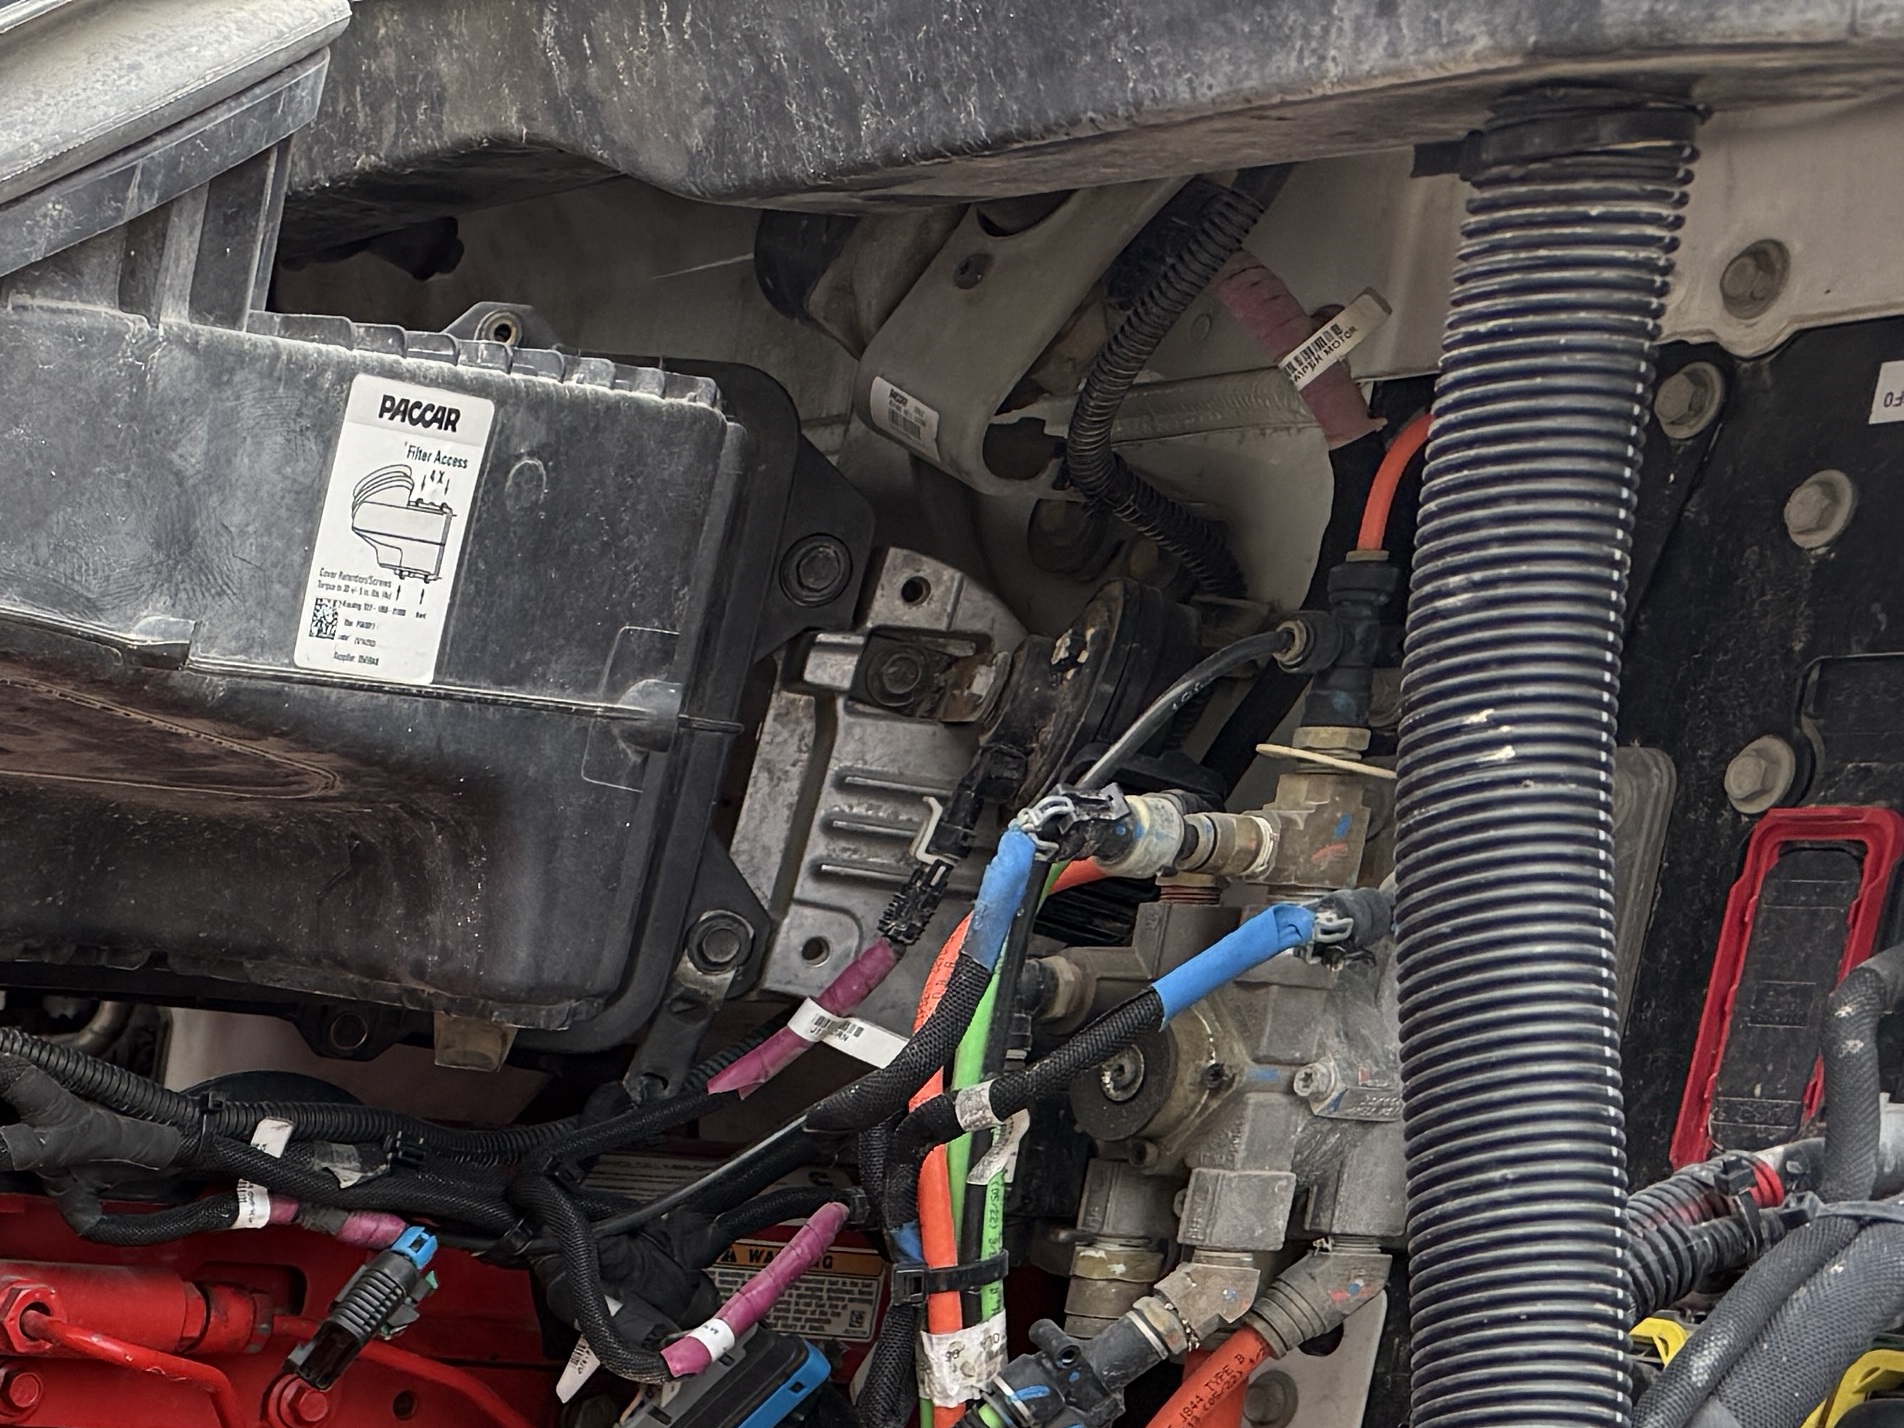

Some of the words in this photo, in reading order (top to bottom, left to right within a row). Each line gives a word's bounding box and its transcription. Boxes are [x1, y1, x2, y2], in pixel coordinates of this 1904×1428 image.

[378, 394, 461, 433] PACCAR
[406, 444, 433, 463] Filter
[433, 450, 469, 469] Access
[1203, 1363, 1234, 1391] TYPE
